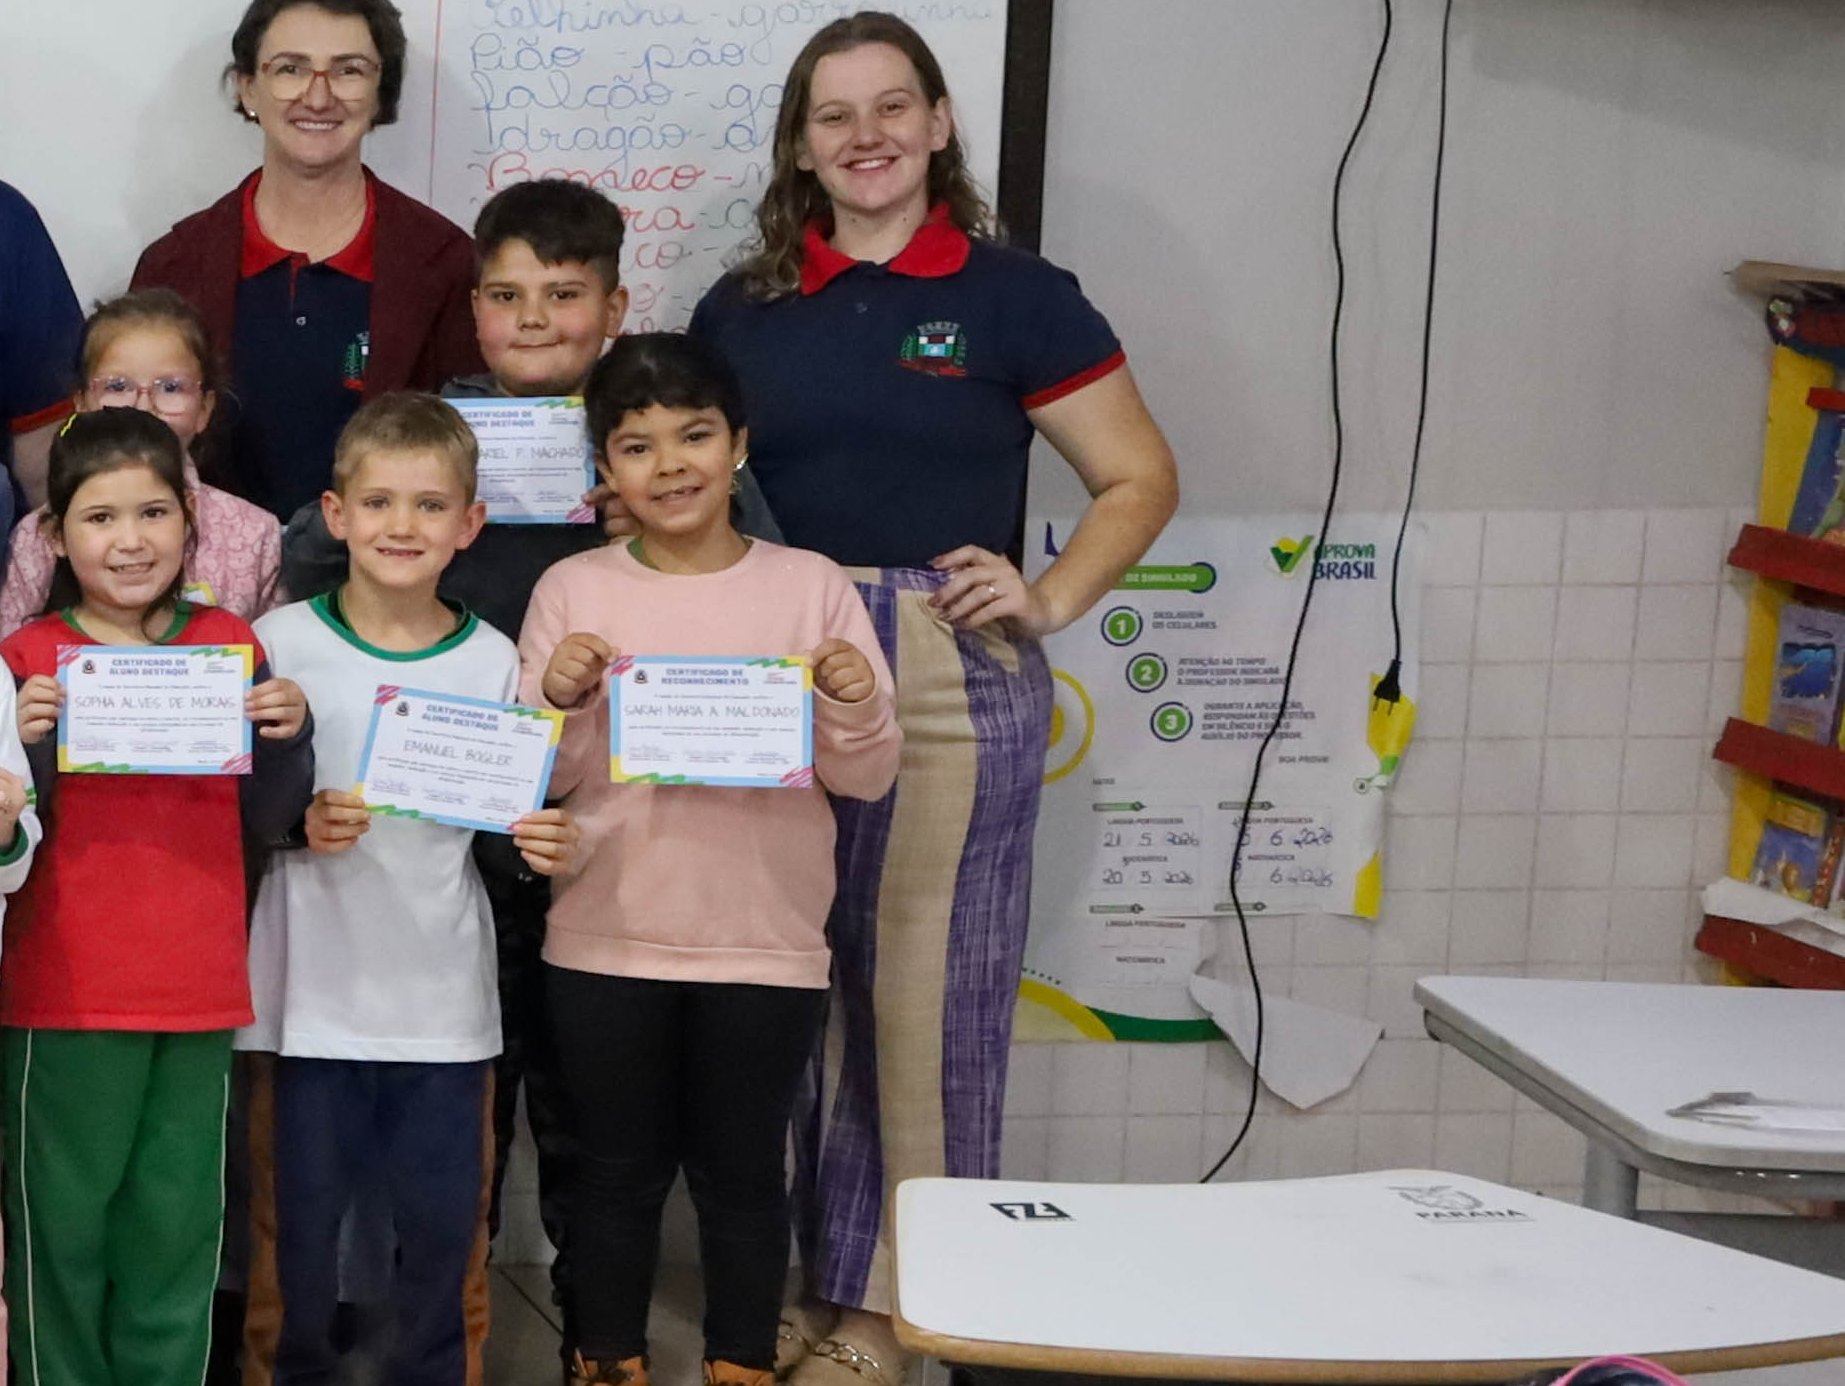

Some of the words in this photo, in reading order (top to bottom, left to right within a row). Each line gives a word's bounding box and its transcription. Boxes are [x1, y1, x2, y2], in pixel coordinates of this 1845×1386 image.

[1117, 619, 1127, 634] 1
[1140, 665, 1152, 680] 2
[168, 695, 185, 708] DE
[1165, 714, 1177, 729] 3
